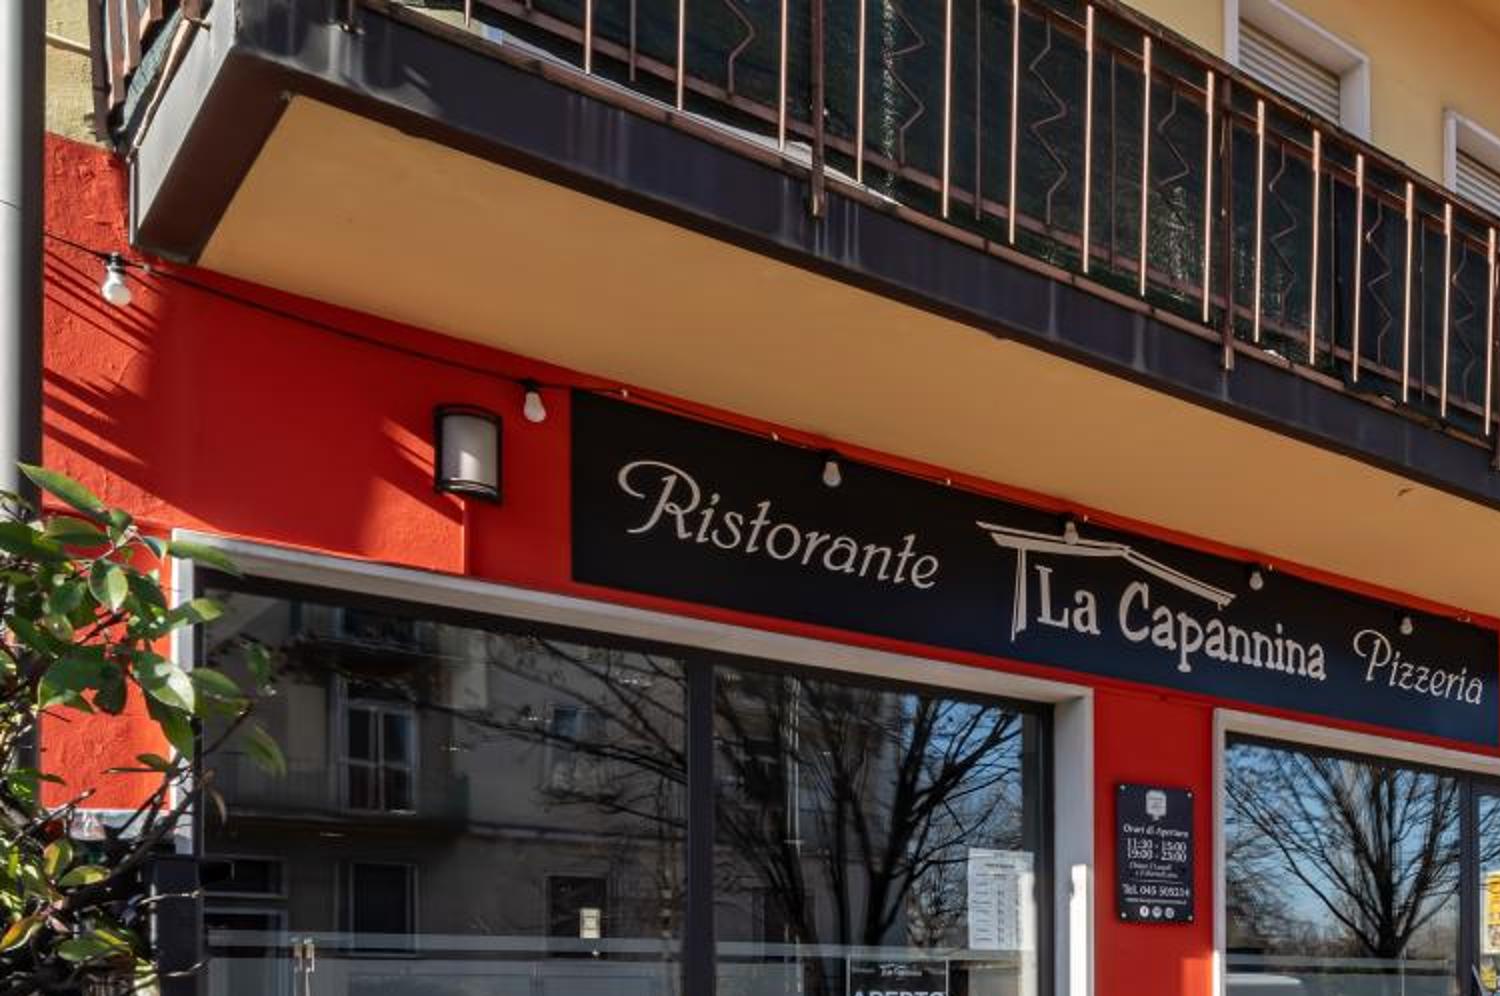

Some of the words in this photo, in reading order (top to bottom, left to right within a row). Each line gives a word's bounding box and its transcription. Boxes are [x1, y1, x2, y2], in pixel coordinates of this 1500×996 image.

[618, 460, 940, 590] Ristorante
[1034, 563, 1101, 636] La
[1118, 580, 1328, 682] Capannina
[1352, 629, 1484, 706] Pizzeria
